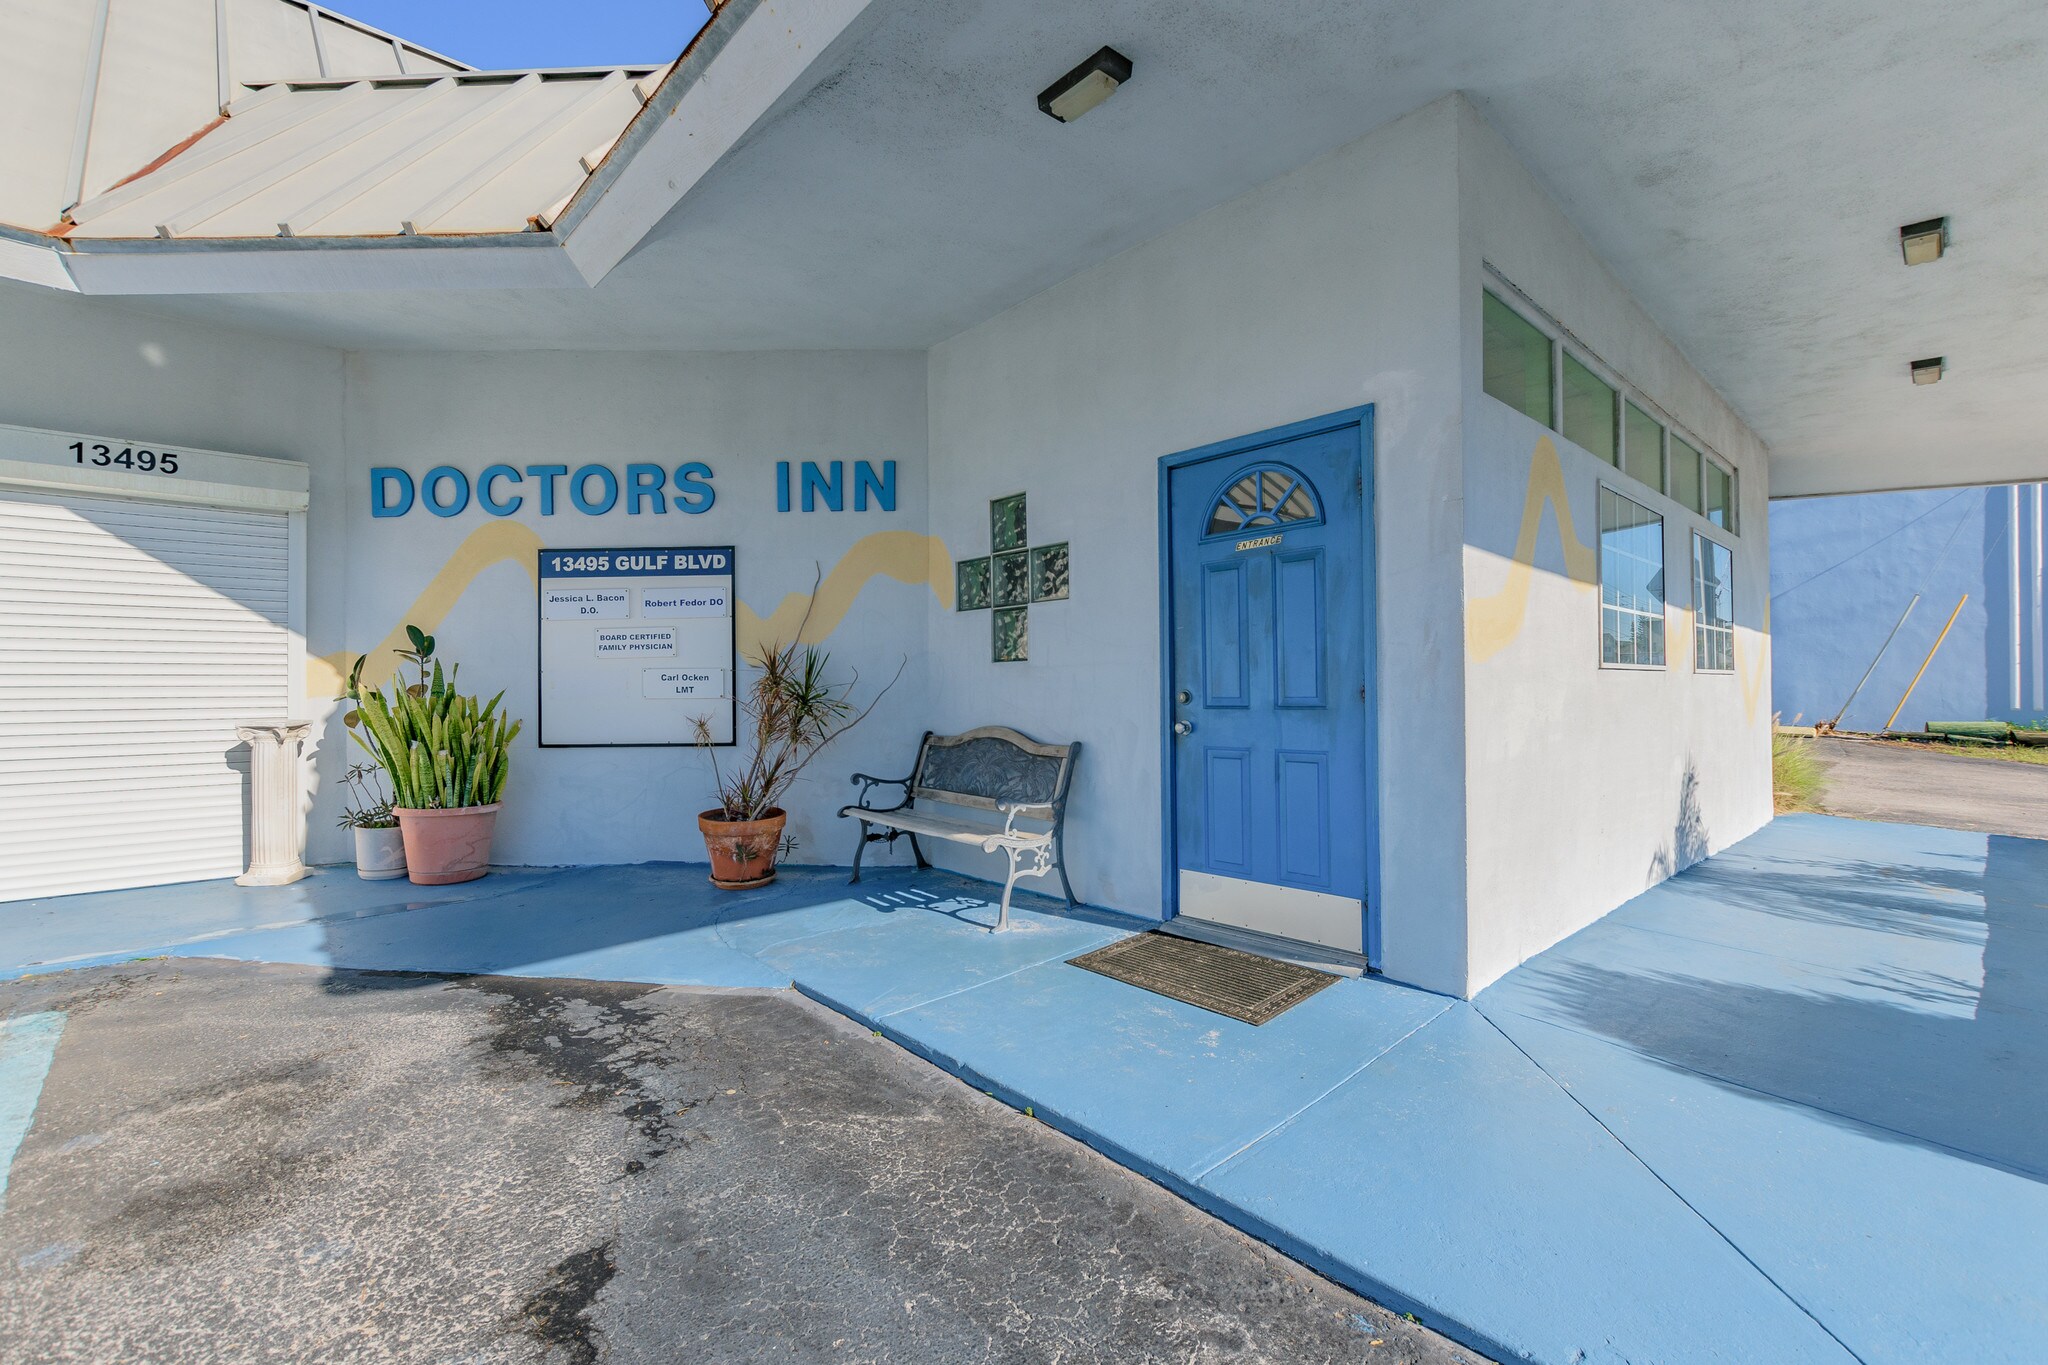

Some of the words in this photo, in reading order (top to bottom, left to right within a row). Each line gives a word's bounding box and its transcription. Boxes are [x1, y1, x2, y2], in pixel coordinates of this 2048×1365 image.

[68, 441, 179, 475] 13495
[370, 461, 716, 518] DOCTORS
[776, 460, 897, 513] INN
[1235, 535, 1283, 551] ENTRANCE
[551, 556, 610, 572] 13495
[615, 555, 668, 571] GULF
[674, 554, 726, 570] BLVD
[549, 594, 583, 603] Jessica
[586, 594, 594, 602] L.
[596, 594, 625, 602] Bacon
[644, 599, 677, 607] Robert
[680, 598, 707, 607] Fedor
[709, 598, 724, 606] DO
[629, 643, 673, 651] PHYSICIAN
[660, 673, 679, 681] Carl
[681, 673, 709, 681] Ocken
[675, 686, 694, 694] LMT
